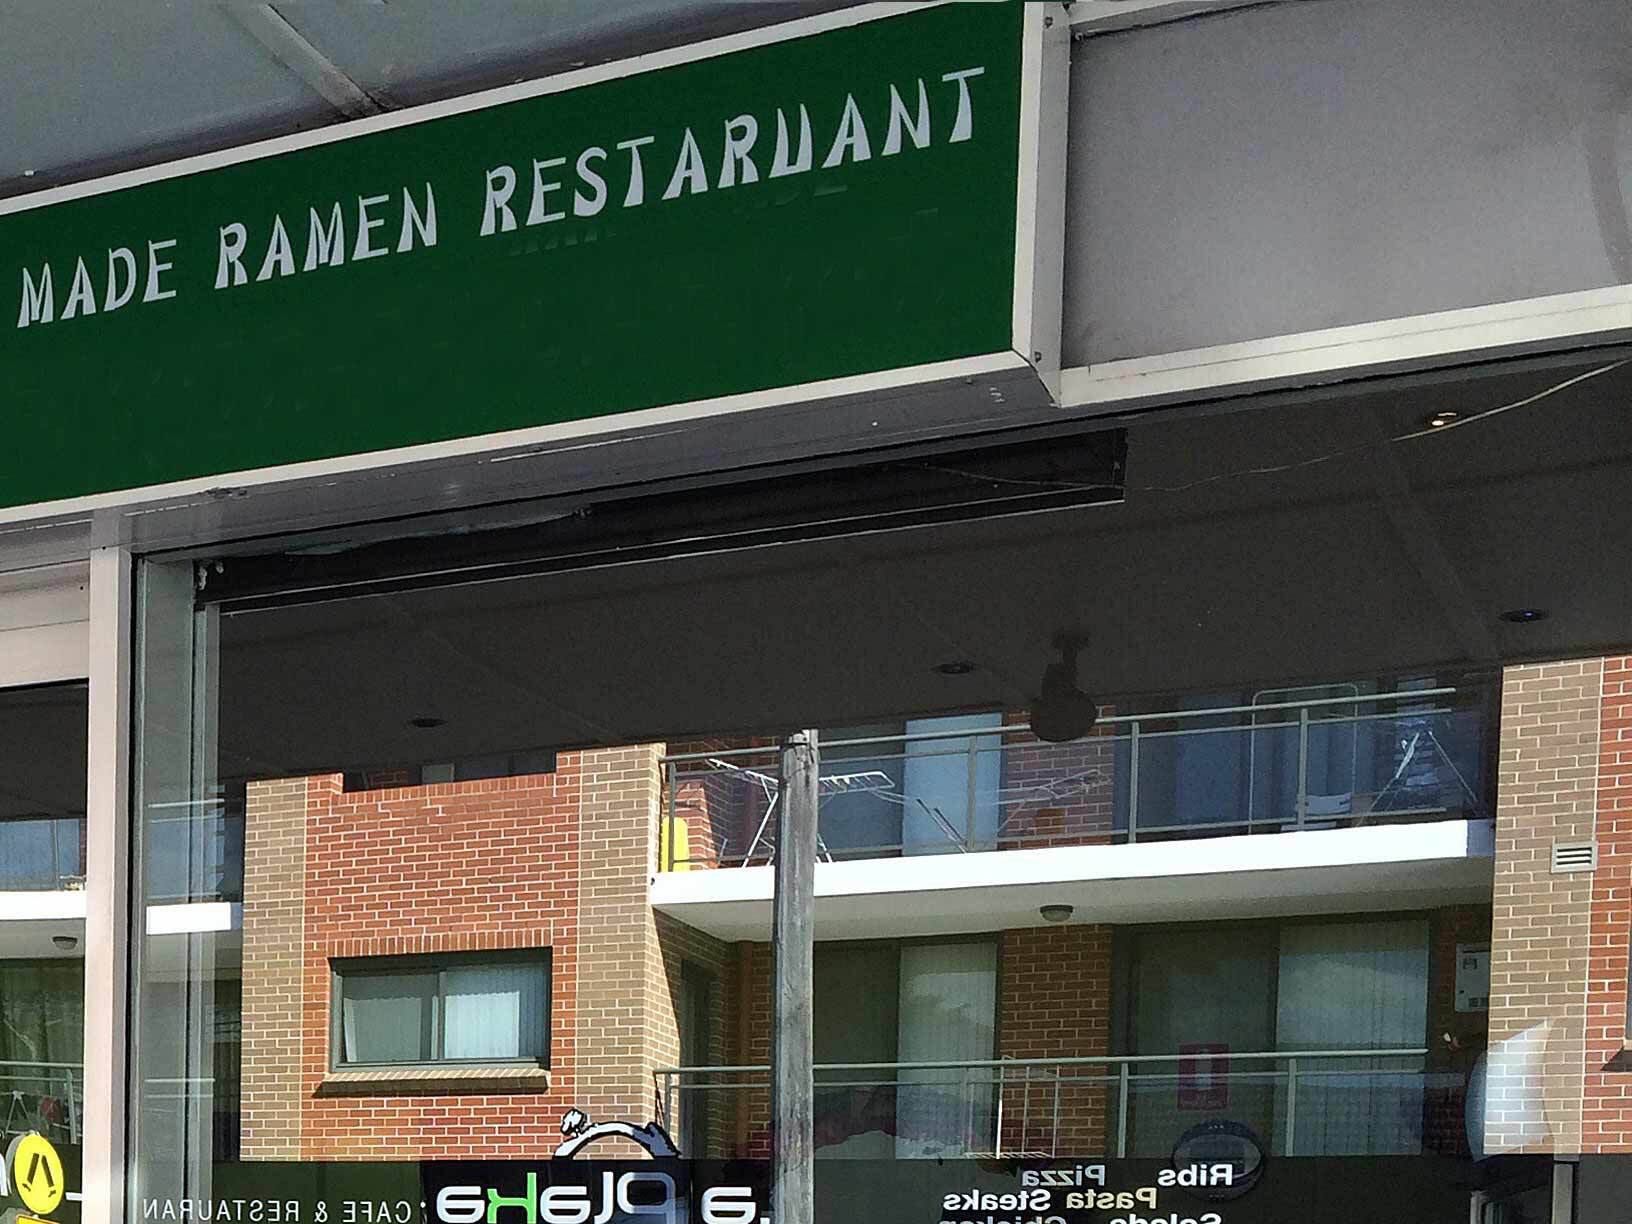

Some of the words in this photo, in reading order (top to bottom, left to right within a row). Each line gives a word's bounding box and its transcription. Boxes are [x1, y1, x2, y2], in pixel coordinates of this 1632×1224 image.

[16, 238, 178, 328] MADE
[213, 180, 439, 291] RAMEN
[479, 66, 987, 238] RESTARUANT
